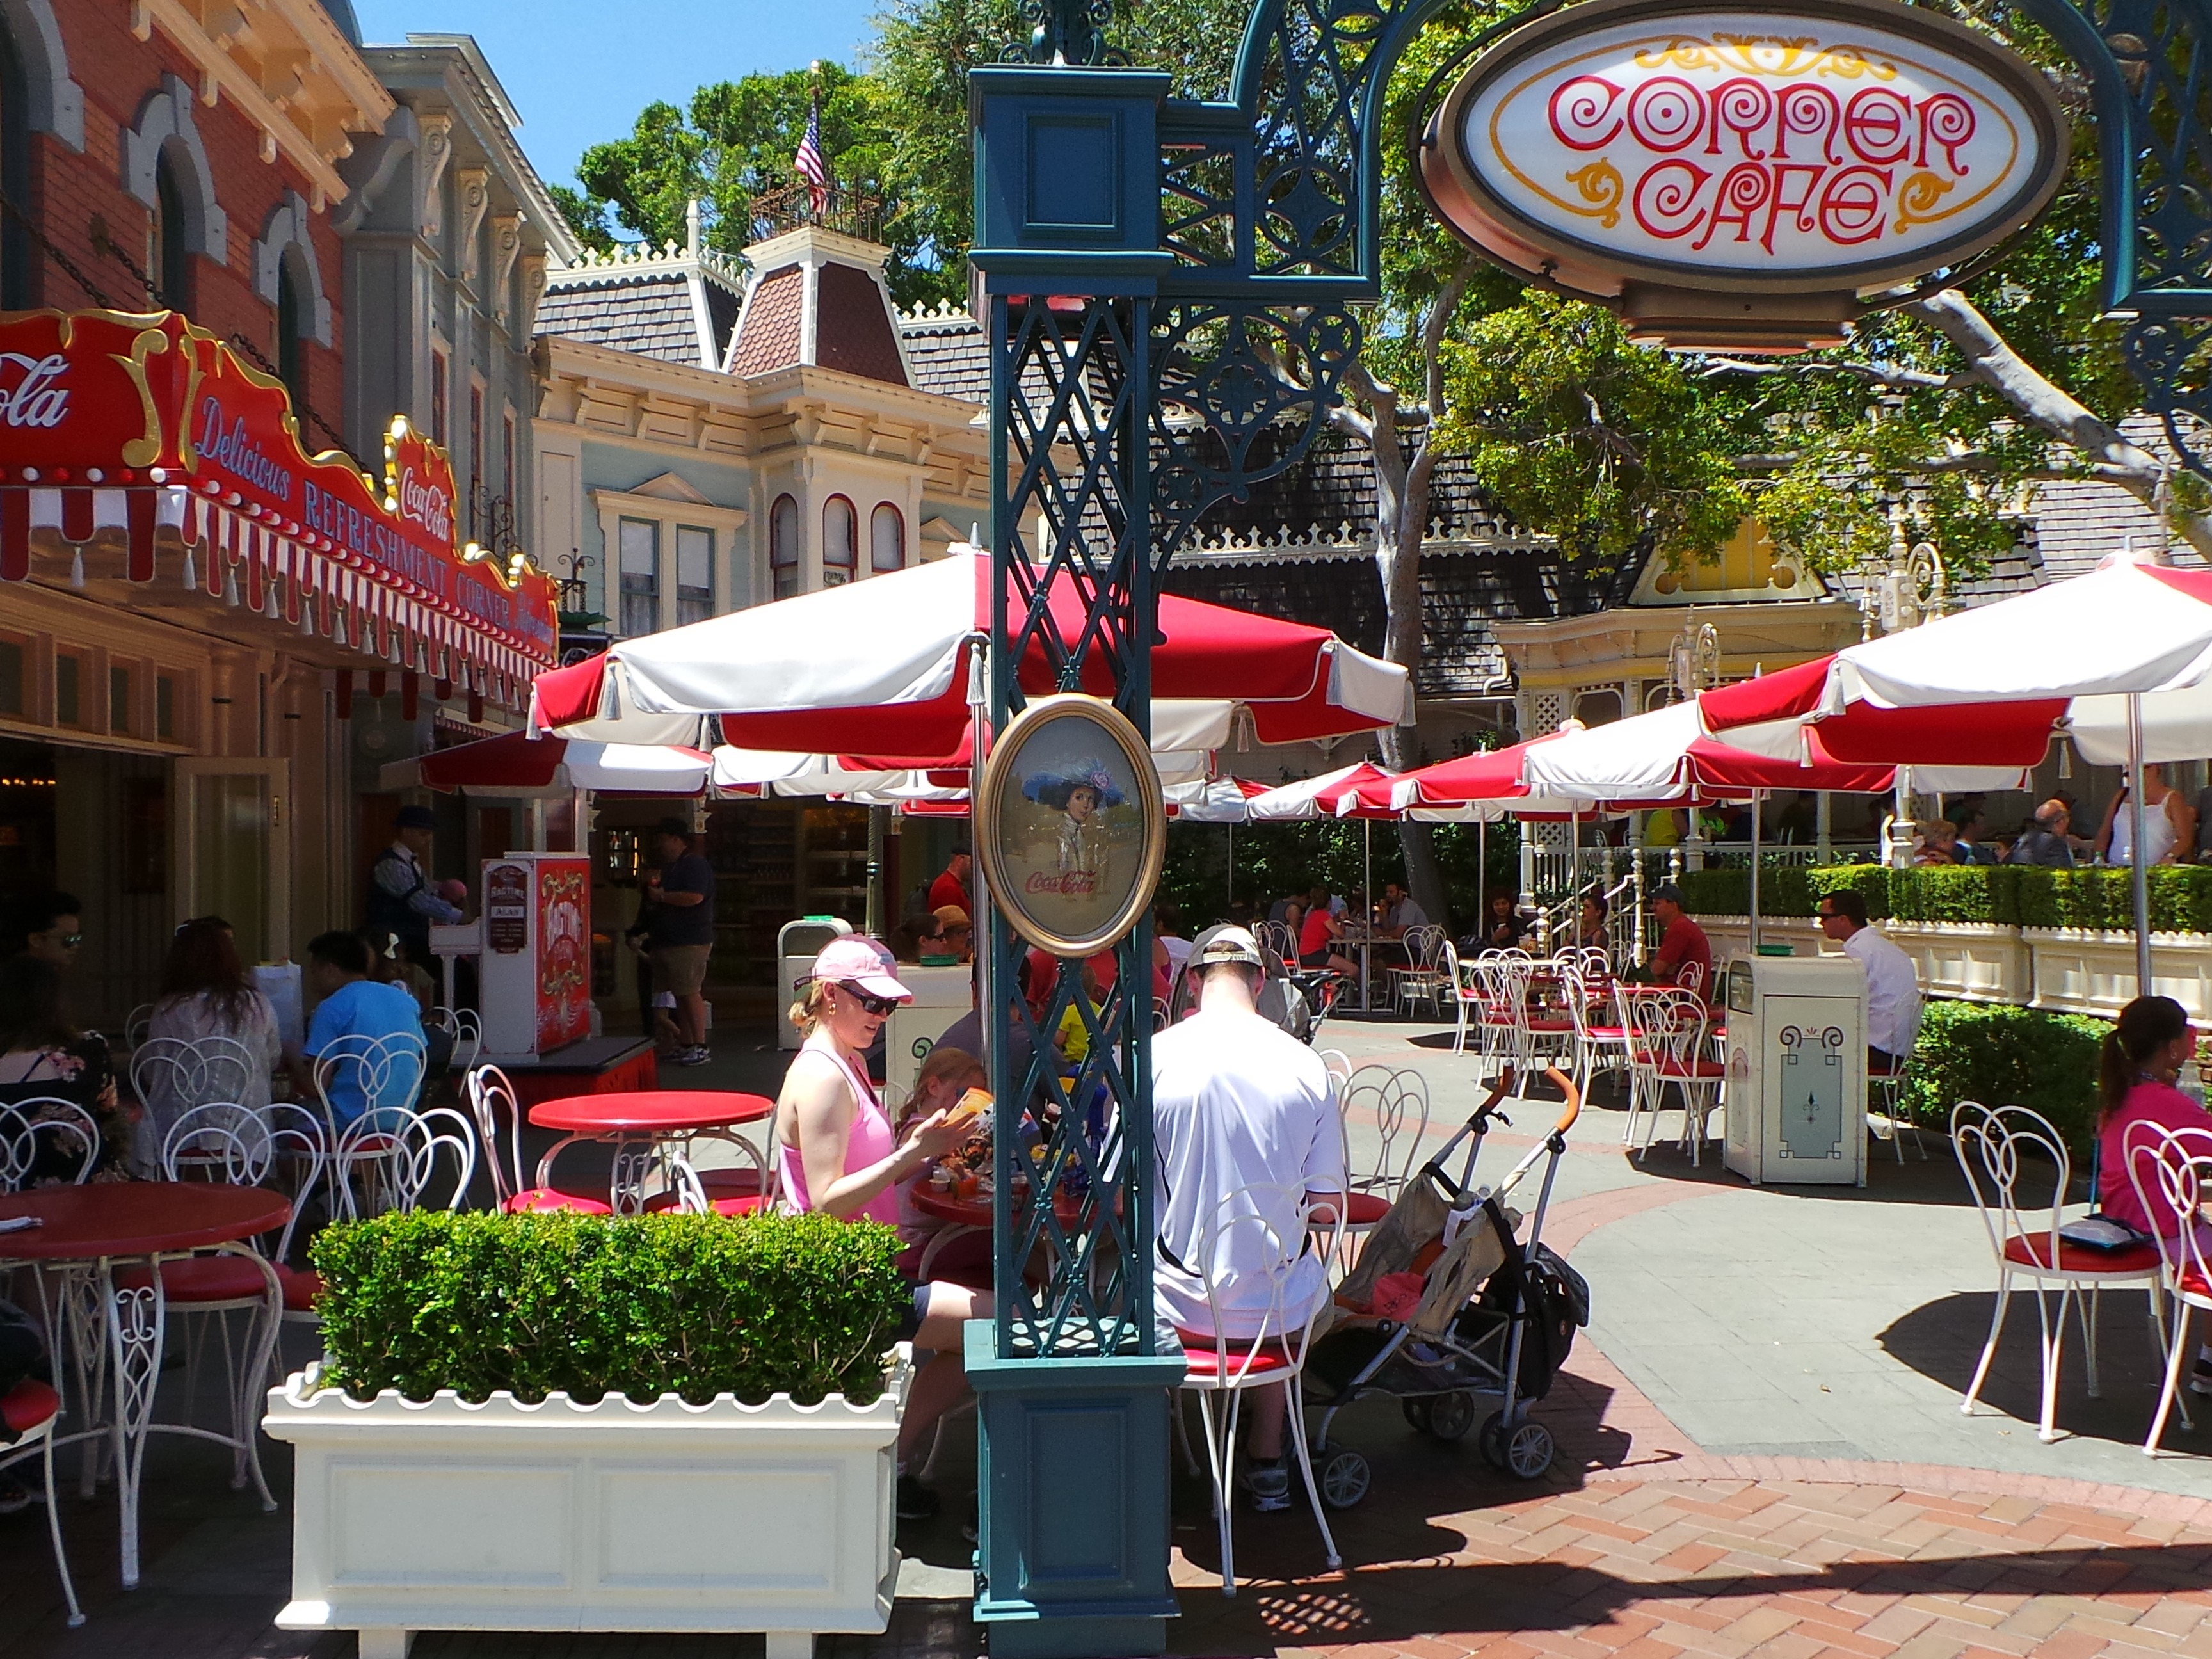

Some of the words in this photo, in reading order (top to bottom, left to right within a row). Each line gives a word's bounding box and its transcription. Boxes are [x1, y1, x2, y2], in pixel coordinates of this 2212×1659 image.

[1548, 74, 1976, 175] CORNER
[1632, 157, 1893, 255] CAFE
[194, 396, 289, 501] Delicious
[303, 478, 447, 596] REFRESHMENT
[456, 572, 509, 629] CORNER
